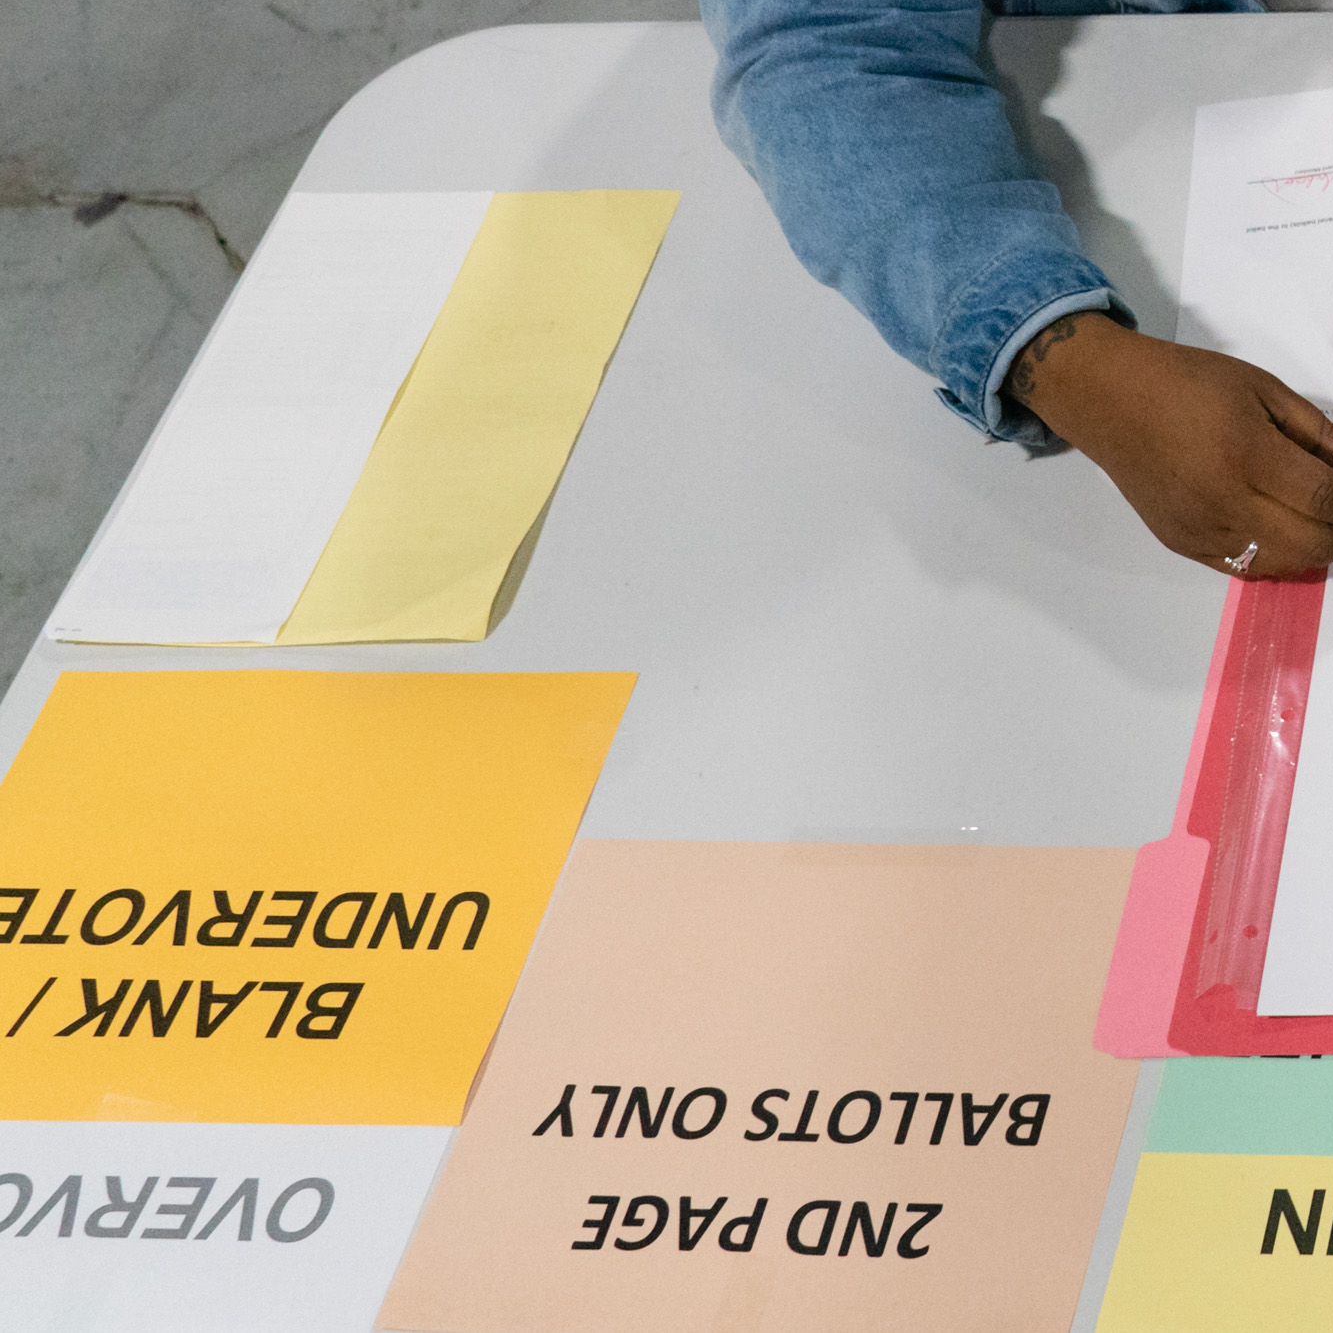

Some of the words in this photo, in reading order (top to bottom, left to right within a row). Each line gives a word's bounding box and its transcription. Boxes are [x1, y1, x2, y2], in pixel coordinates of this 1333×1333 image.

[6, 977, 56, 1040] /
[54, 978, 365, 1040] BLANK
[533, 1084, 727, 1140] ONLY
[744, 1088, 1051, 1147] BALLOTS
[571, 1195, 768, 1253] PAGE
[786, 1200, 943, 1259] 2ND
